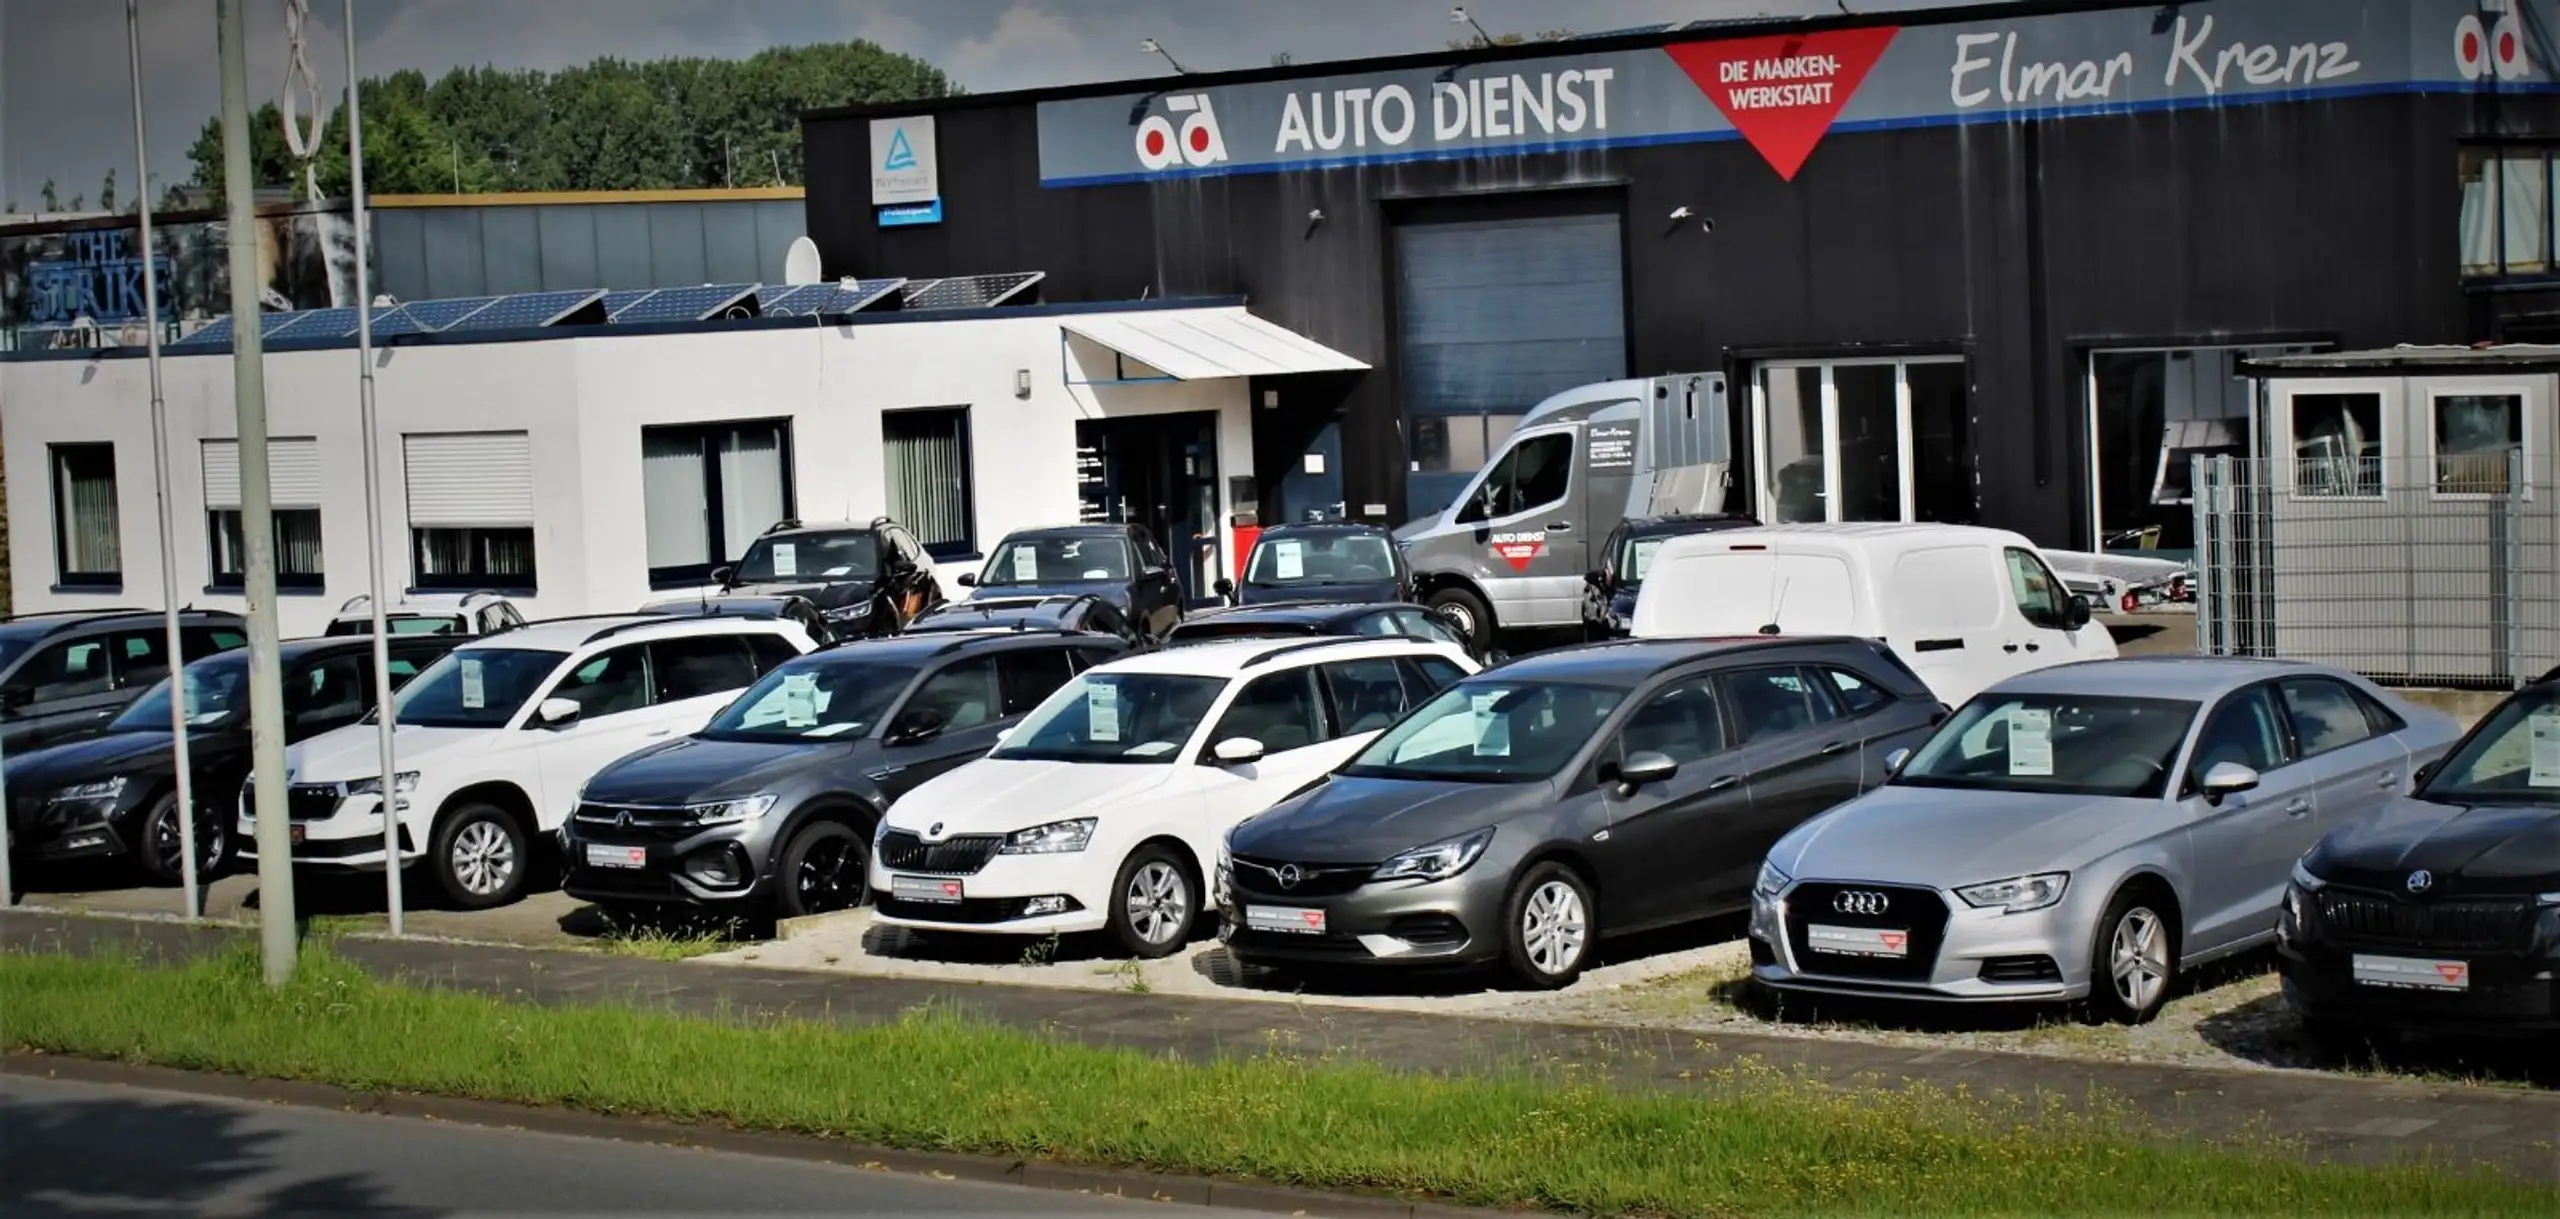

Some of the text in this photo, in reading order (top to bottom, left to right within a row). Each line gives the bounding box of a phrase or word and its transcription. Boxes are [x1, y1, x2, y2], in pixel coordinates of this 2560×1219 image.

[1720, 54, 1842, 83] DIE MARKEN-
[1951, 14, 2360, 107] Elmar Krenz
[1275, 68, 1614, 152] AUTO DIENST
[1728, 82, 1833, 110] WERKSTATT
[68, 231, 122, 267] THE
